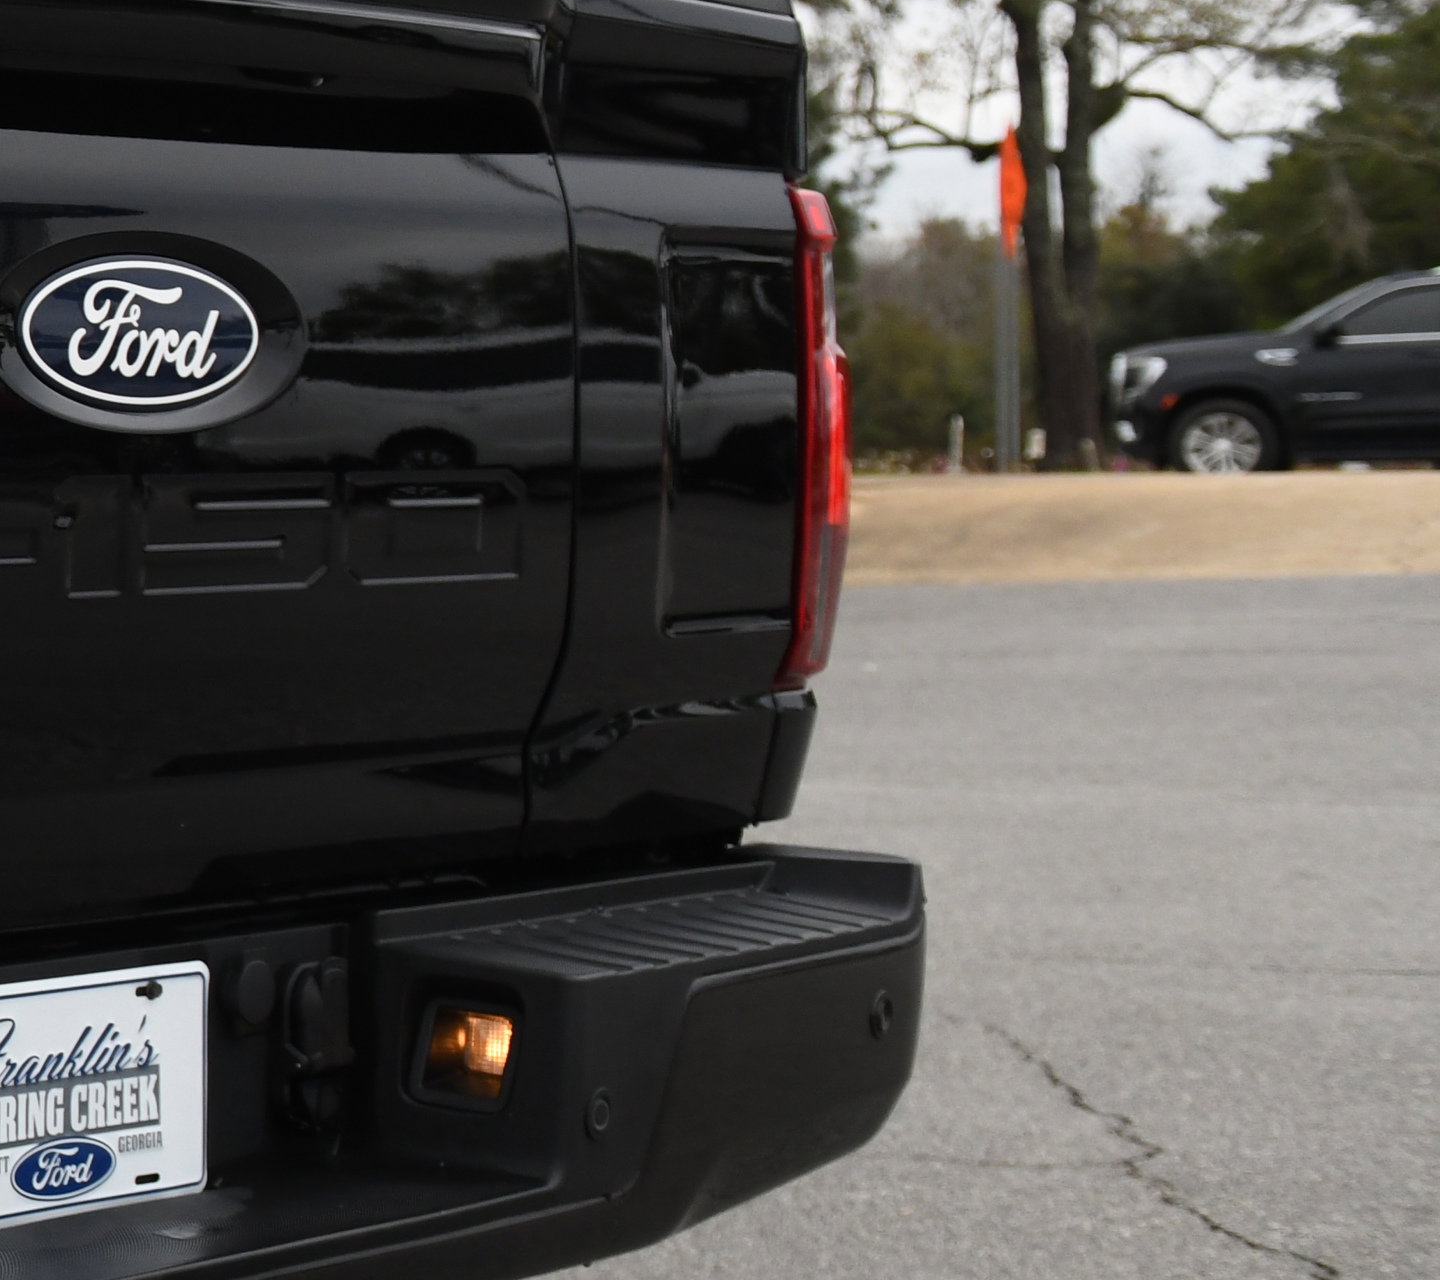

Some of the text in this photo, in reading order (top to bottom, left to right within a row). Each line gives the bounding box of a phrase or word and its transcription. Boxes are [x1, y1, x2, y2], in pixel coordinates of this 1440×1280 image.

[67, 278, 221, 379] Ford
[69, 1073, 160, 1133] CREEK
[32, 1145, 95, 1191] Ford
[117, 1130, 164, 1154] GEORGIA
